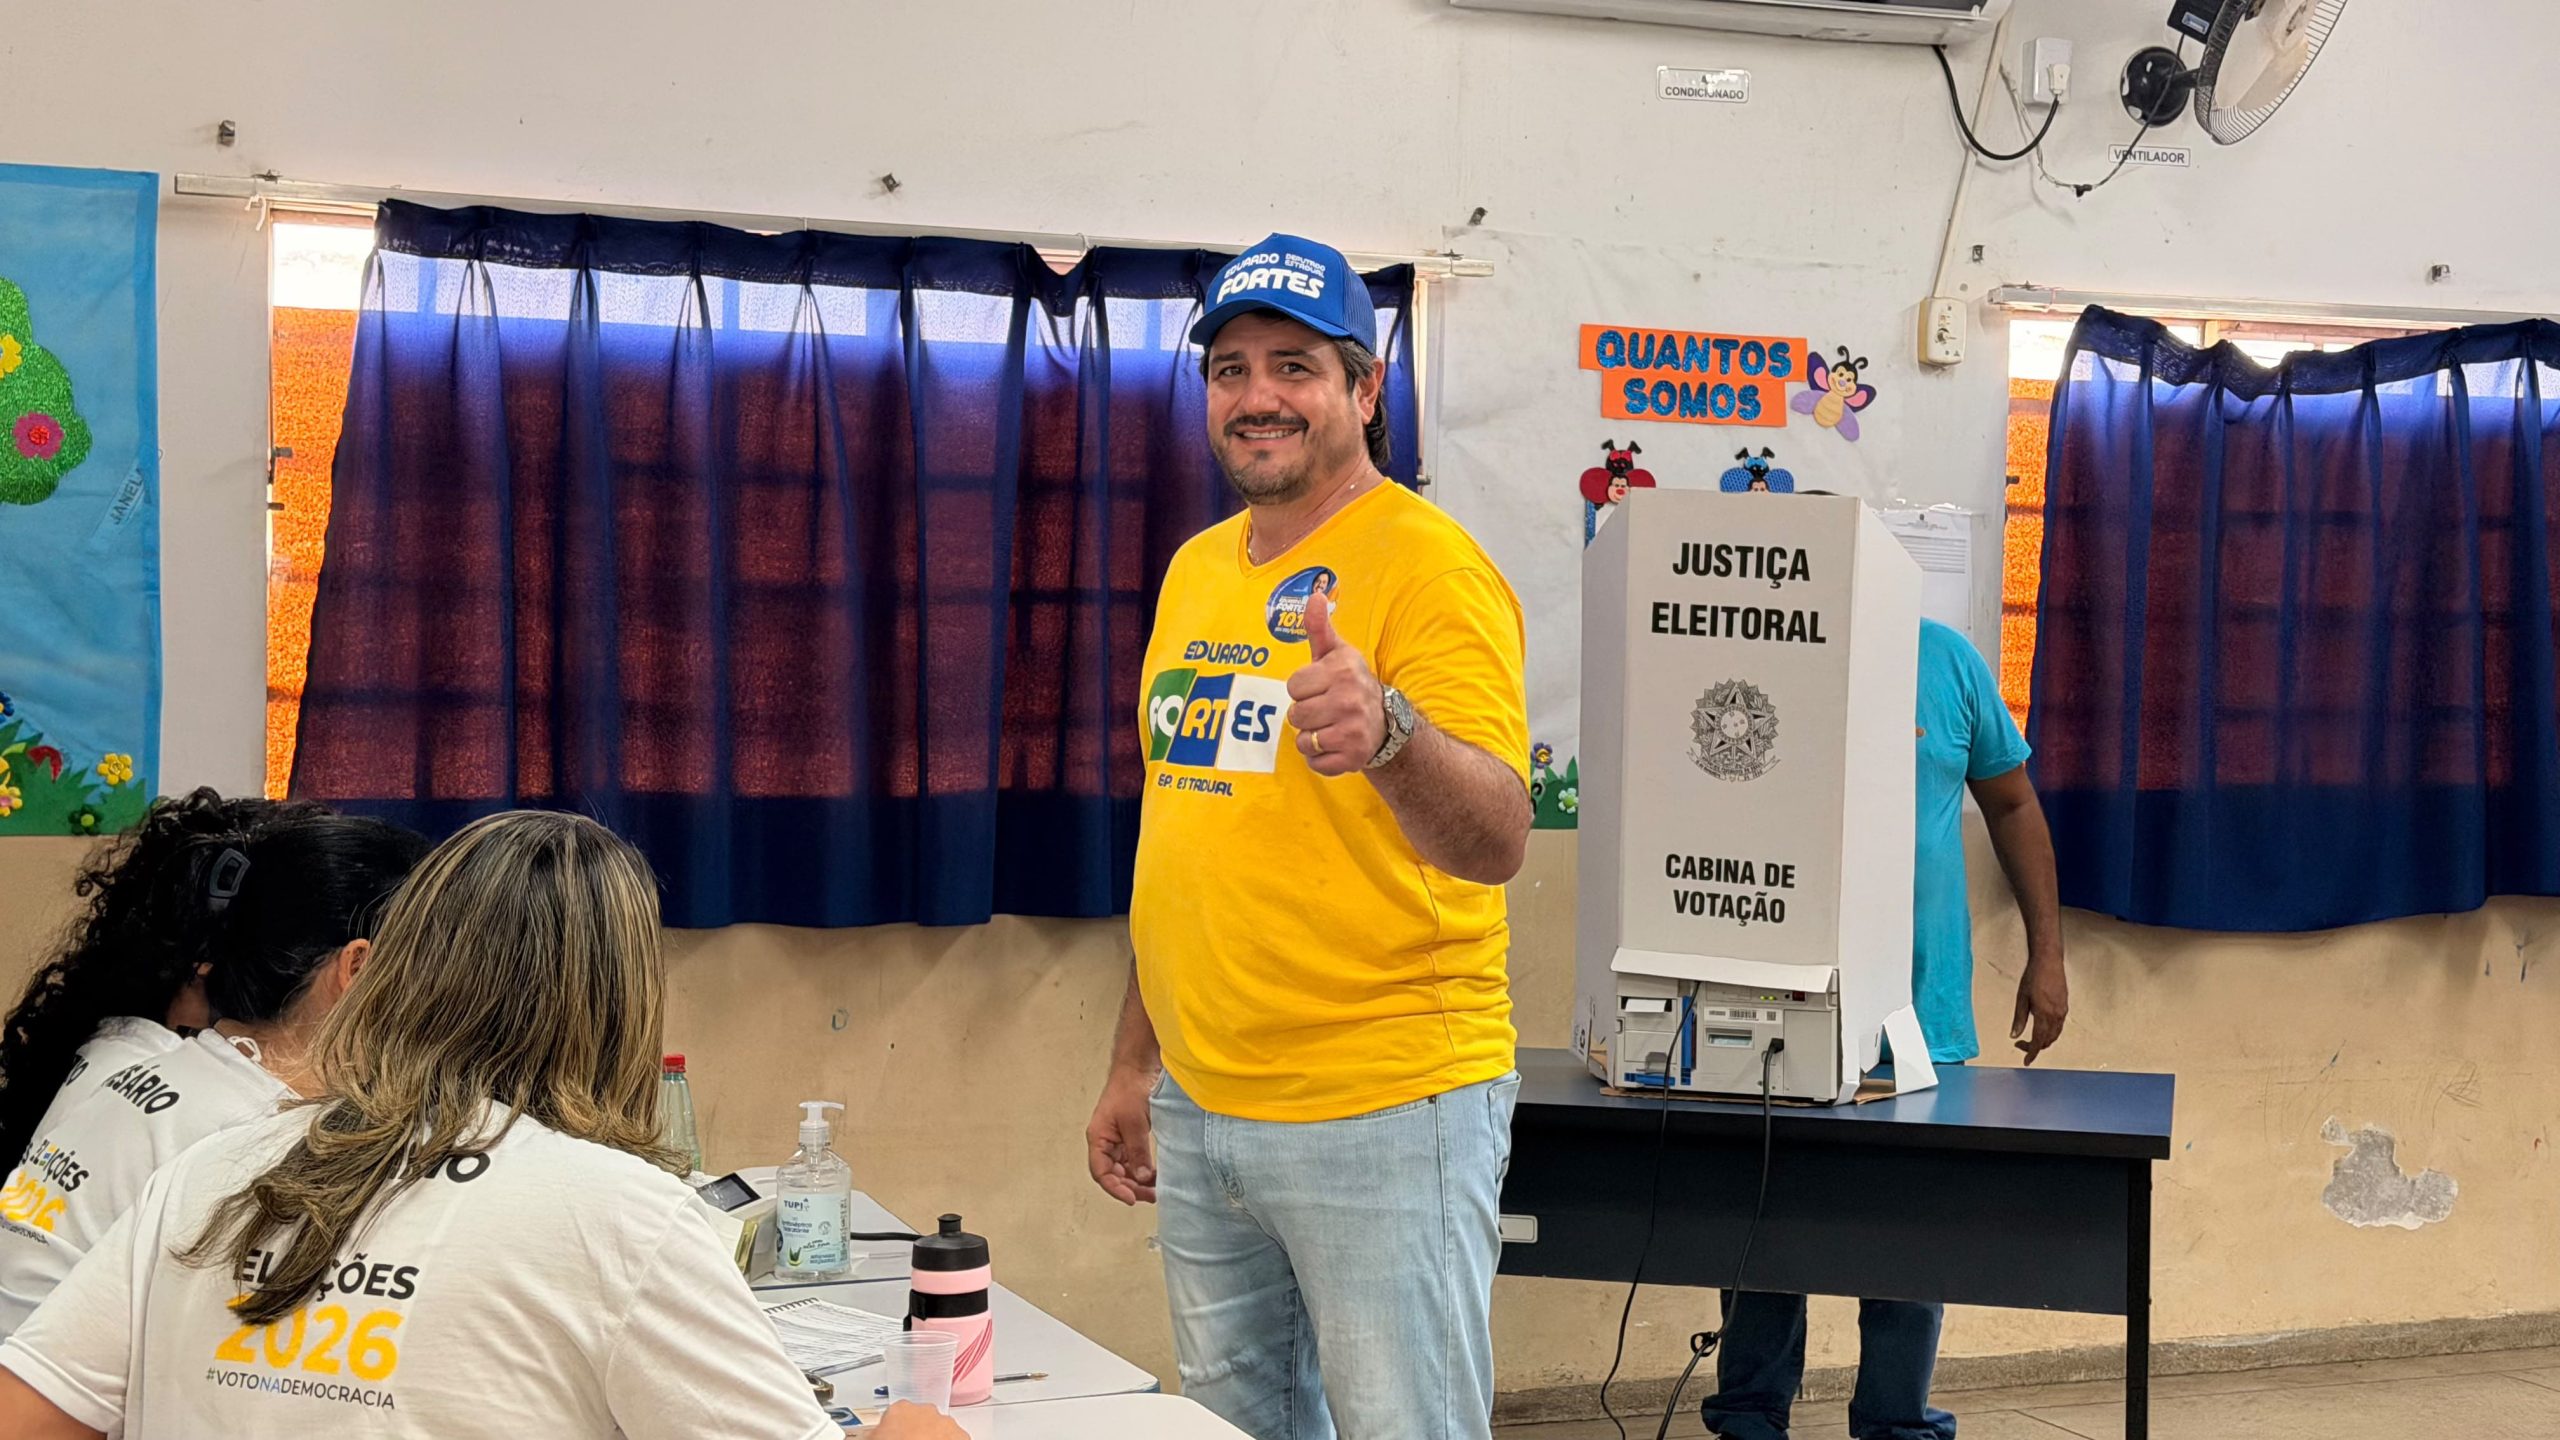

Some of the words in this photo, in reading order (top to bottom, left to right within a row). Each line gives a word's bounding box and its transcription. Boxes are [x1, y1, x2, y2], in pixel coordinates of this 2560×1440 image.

[1664, 86, 1744, 100] CONDICIONADO
[2113, 149, 2185, 164] VENTILADOR
[1224, 253, 1280, 279] EDUARDO
[1284, 260, 1325, 278] ESTADUAL
[1285, 253, 1326, 272] DEPUTADO
[1216, 268, 1325, 305] FORTES
[1596, 330, 1792, 378] QUANTOS
[1623, 378, 1760, 420] SOMOS
[110, 467, 144, 525] JANEL
[1672, 542, 1811, 589] JUSTIÇA
[1278, 611, 1305, 628] 101
[1651, 601, 1827, 644] ELEITORAL
[1184, 640, 1270, 667] EDUARDO
[1157, 773, 1173, 788] EP.
[1176, 777, 1233, 797] ESTADUAL
[1665, 853, 1756, 886] CABINA
[1763, 862, 1796, 889] DE
[1673, 889, 1786, 927] VOTAÇÃO
[783, 1200, 804, 1211] TUPI
[232, 1249, 421, 1301] ELÕES
[214, 1292, 405, 1382] 2026
[206, 1367, 396, 1410] #VOTONADEMOCRACIA
